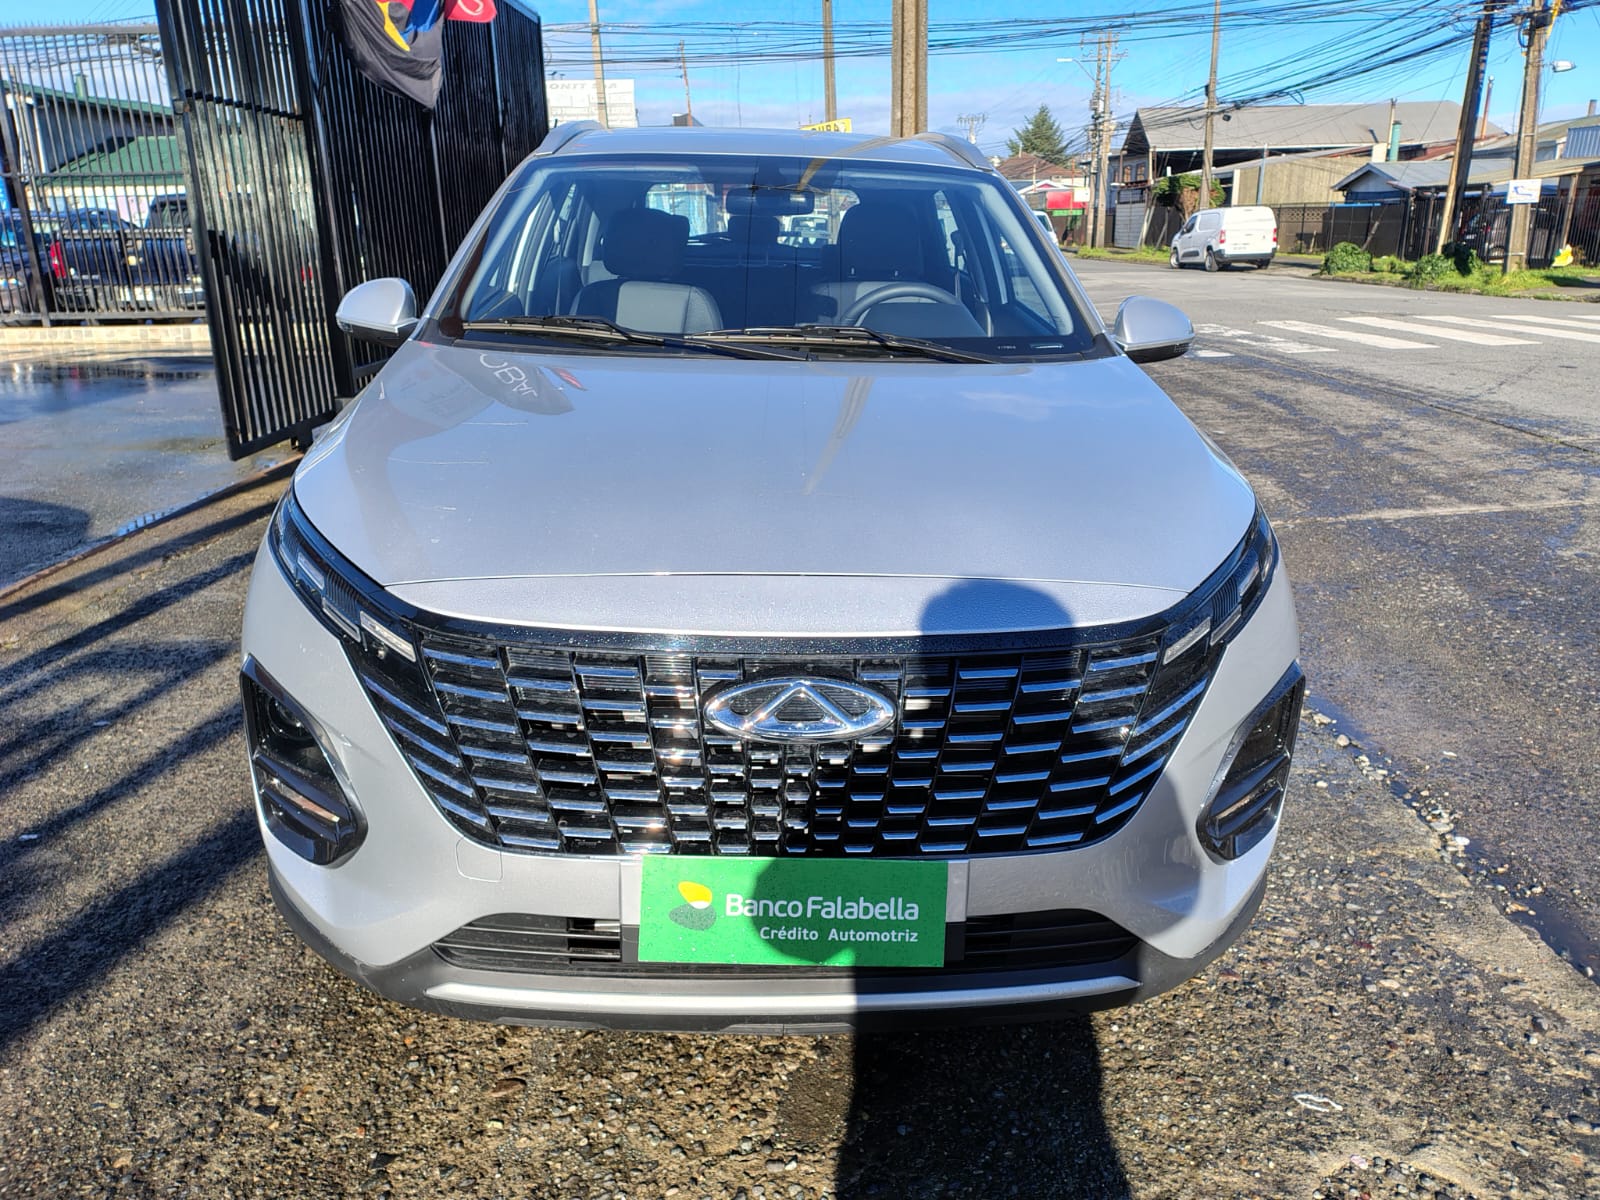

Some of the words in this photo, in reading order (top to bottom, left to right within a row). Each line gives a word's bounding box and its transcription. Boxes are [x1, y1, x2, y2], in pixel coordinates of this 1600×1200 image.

[726, 894, 802, 917] Banco
[807, 897, 918, 920] Falabella
[761, 927, 818, 940] Crédito
[828, 929, 918, 942] Automotriz
